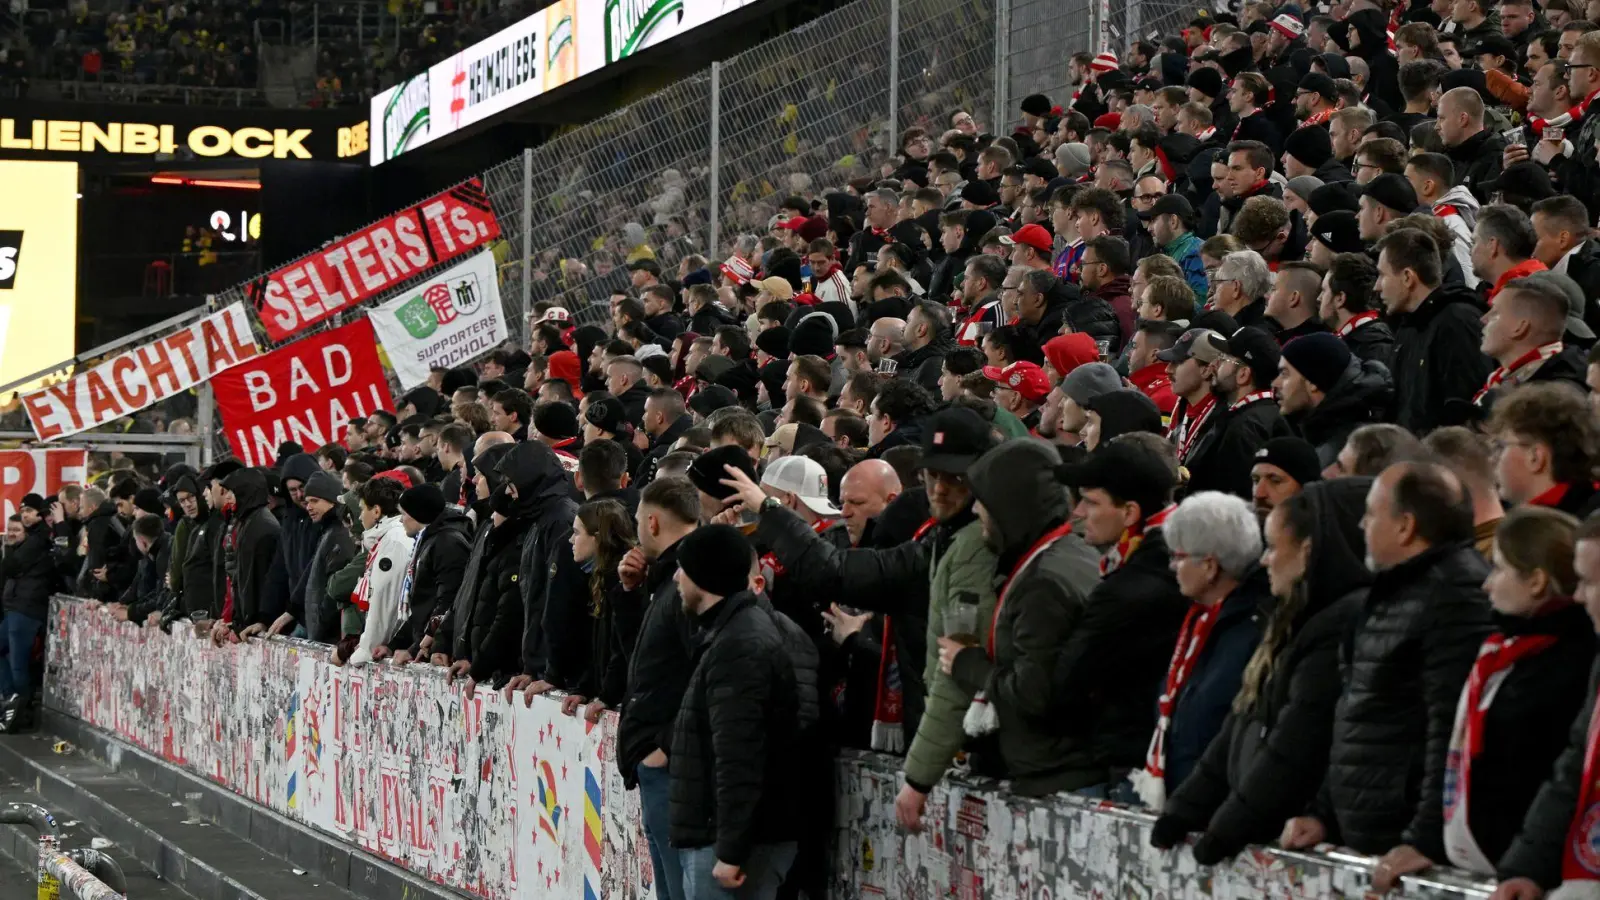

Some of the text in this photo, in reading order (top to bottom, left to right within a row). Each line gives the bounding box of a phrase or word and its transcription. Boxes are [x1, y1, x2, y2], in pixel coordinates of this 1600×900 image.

[264, 216, 430, 331] SELTERS
[23, 311, 256, 441] EYACHTAL
[243, 343, 353, 412] BAD
[416, 314, 497, 362] SUPPORTERS
